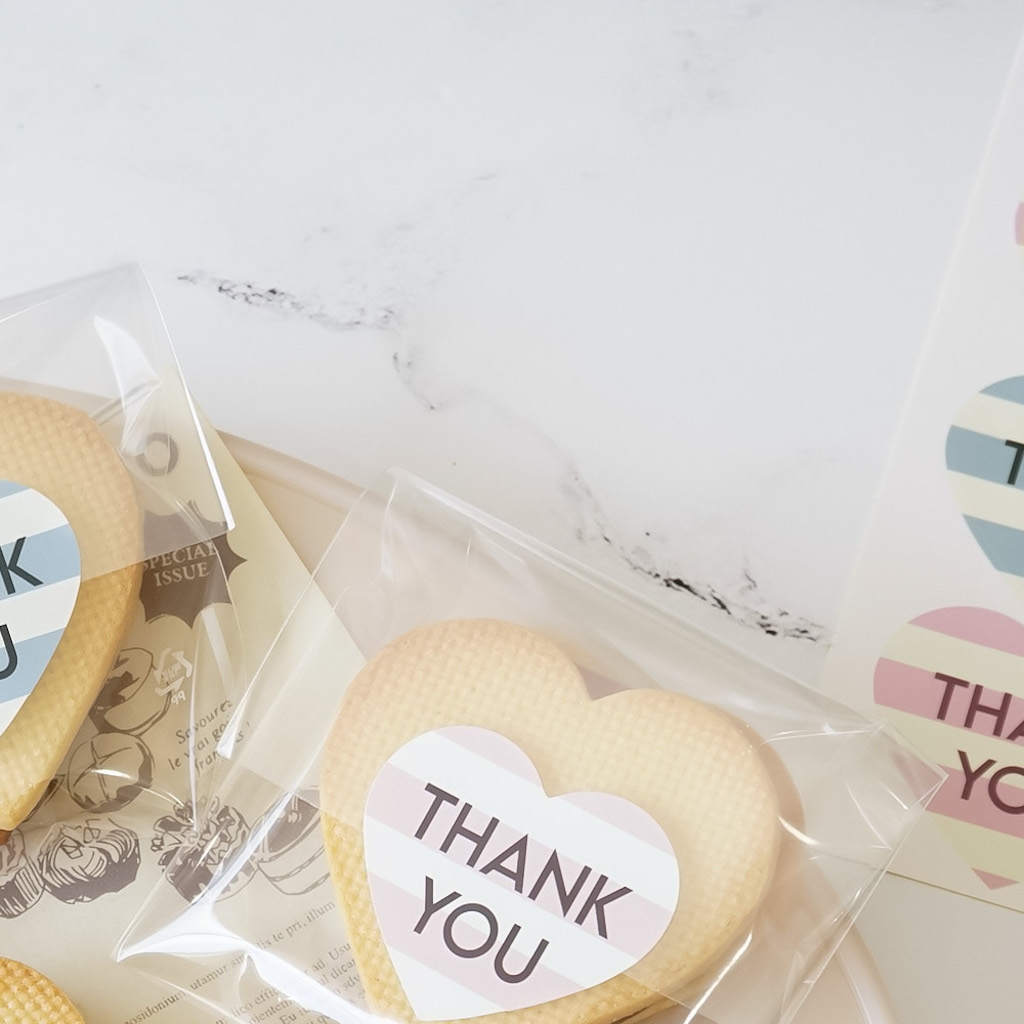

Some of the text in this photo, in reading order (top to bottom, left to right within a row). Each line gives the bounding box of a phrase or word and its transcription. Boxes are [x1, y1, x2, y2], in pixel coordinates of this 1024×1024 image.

[143, 541, 216, 570] SPECIAL
[154, 562, 209, 587] ISSUE
[956, 749, 1024, 815] YO
[414, 782, 633, 939] THANK
[413, 875, 550, 984] YOU
